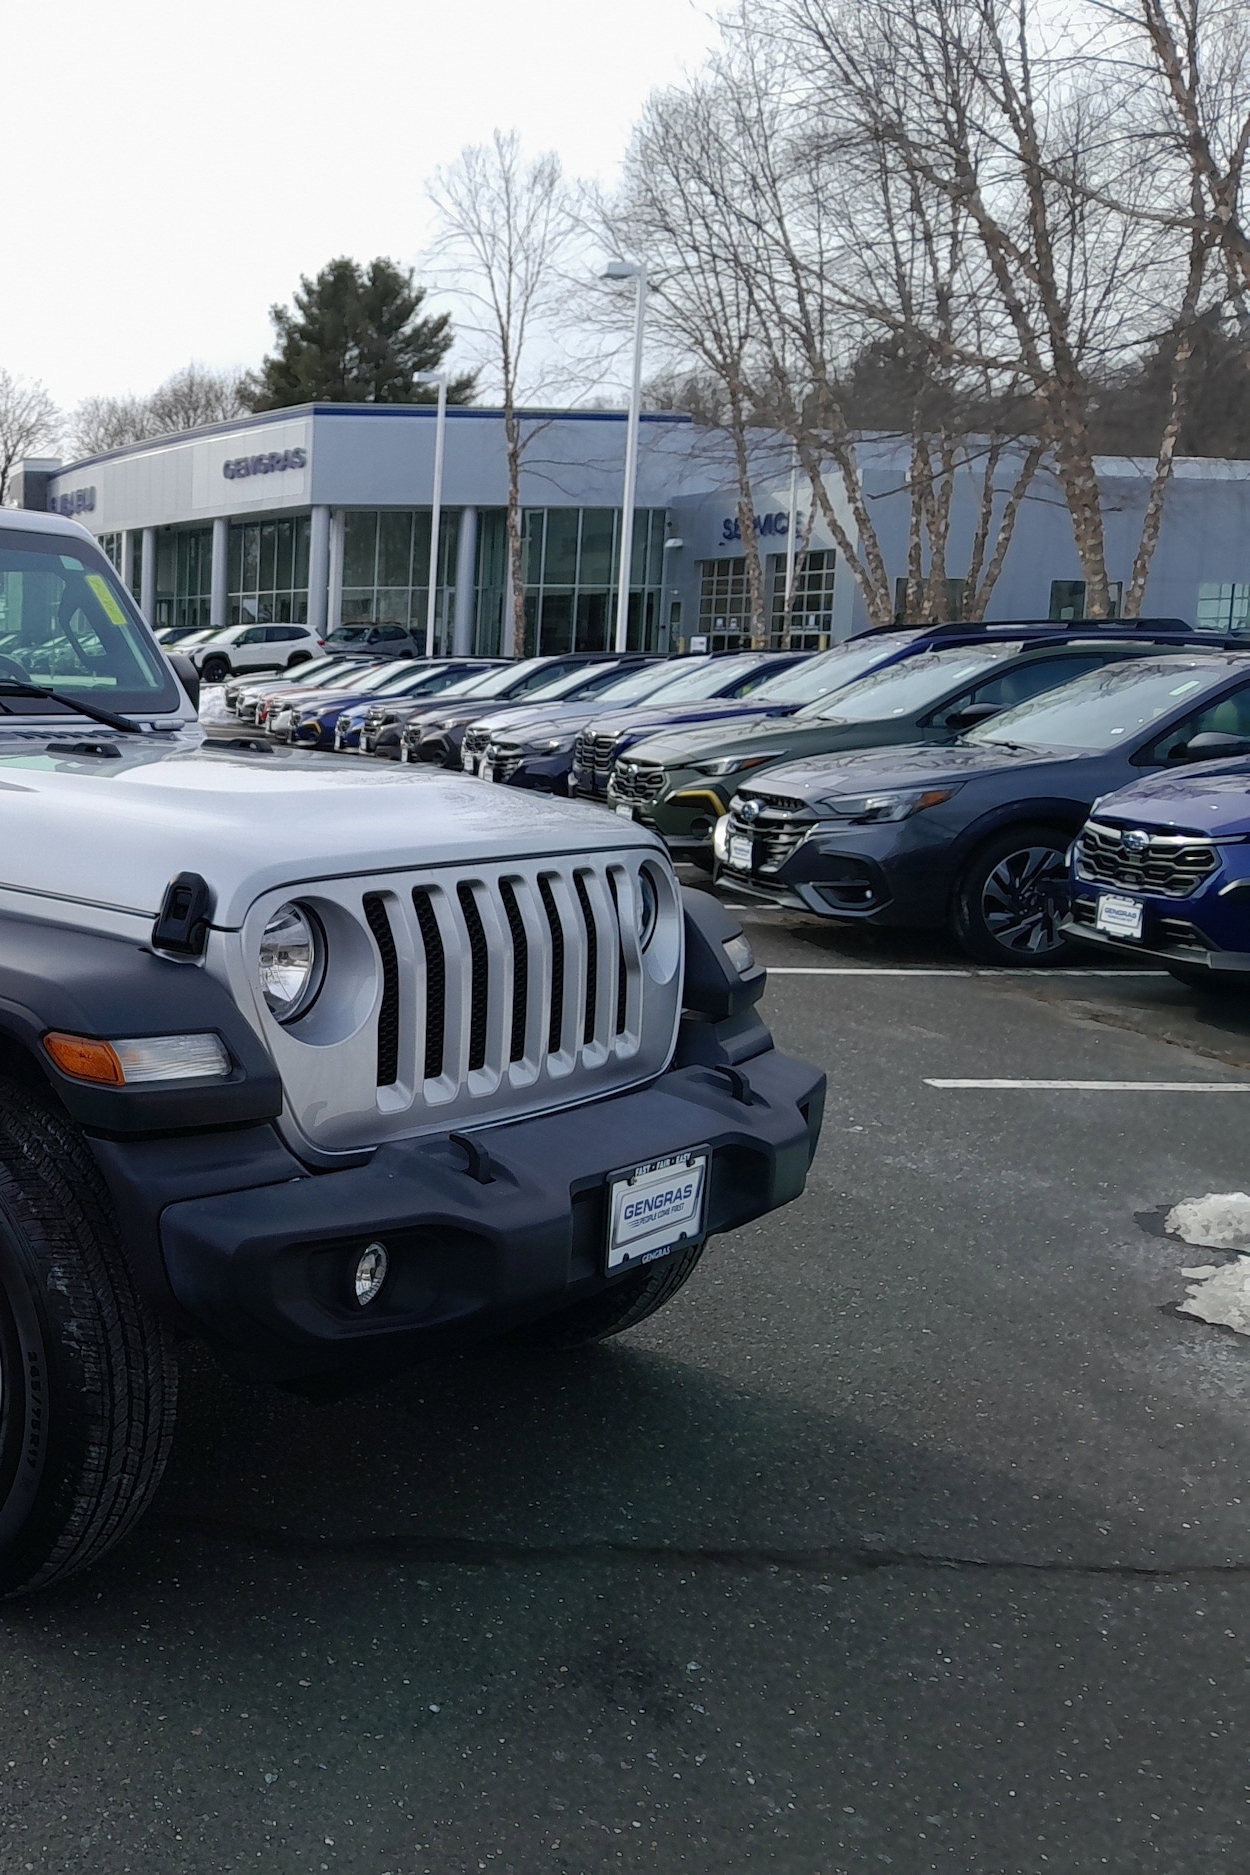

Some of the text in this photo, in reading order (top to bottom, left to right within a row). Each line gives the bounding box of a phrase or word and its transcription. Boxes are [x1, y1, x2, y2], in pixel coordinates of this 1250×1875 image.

[223, 447, 307, 479] GENGRAS
[635, 1153, 692, 1177] FAST FAIR EASY
[624, 1183, 693, 1220] GENGRAS
[671, 1202, 685, 1214] FIRST
[641, 1246, 671, 1264] GENGRAS
